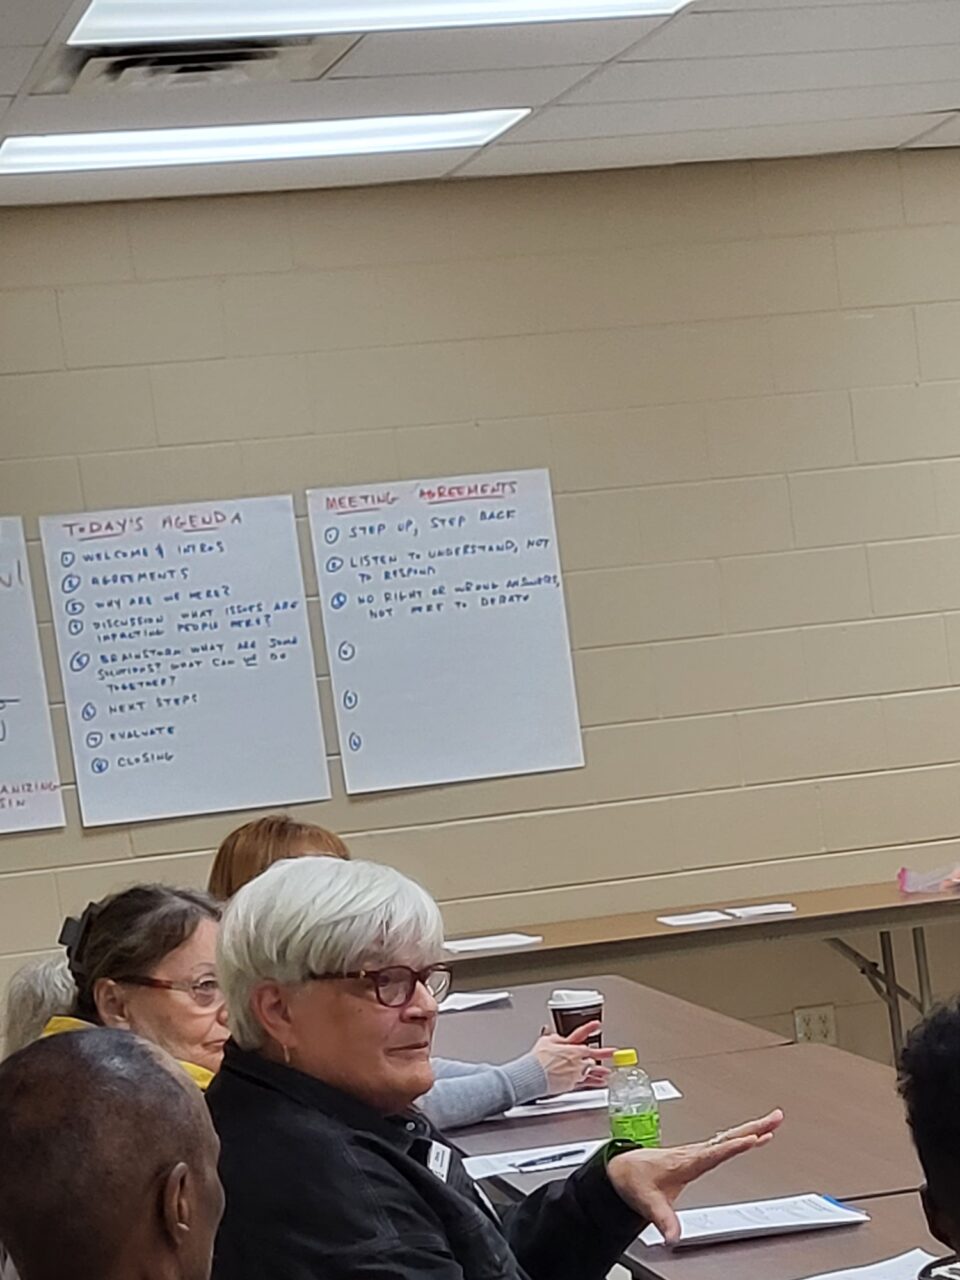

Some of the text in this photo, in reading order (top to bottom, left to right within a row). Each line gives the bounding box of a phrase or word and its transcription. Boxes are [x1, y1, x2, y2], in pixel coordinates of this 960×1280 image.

[326, 492, 399, 510] MEETING
[62, 510, 242, 538] TODAY'S AGENDA
[349, 523, 386, 538] STEP
[397, 519, 419, 536] UP,
[430, 516, 466, 529] STEP
[480, 509, 516, 521] BACK
[82, 547, 149, 561] WELCOME
[178, 541, 225, 555] INTROS
[350, 555, 398, 569] LISTEN
[408, 552, 421, 560] TO
[428, 540, 519, 559] UNDERSTAND,
[527, 538, 550, 548] NOT
[129, 595, 151, 606] ARE
[108, 701, 147, 715] NEXT
[110, 726, 175, 741] EVALUATE
[117, 752, 174, 768] CLOSING
[0, 781, 58, 793] ANIZING
